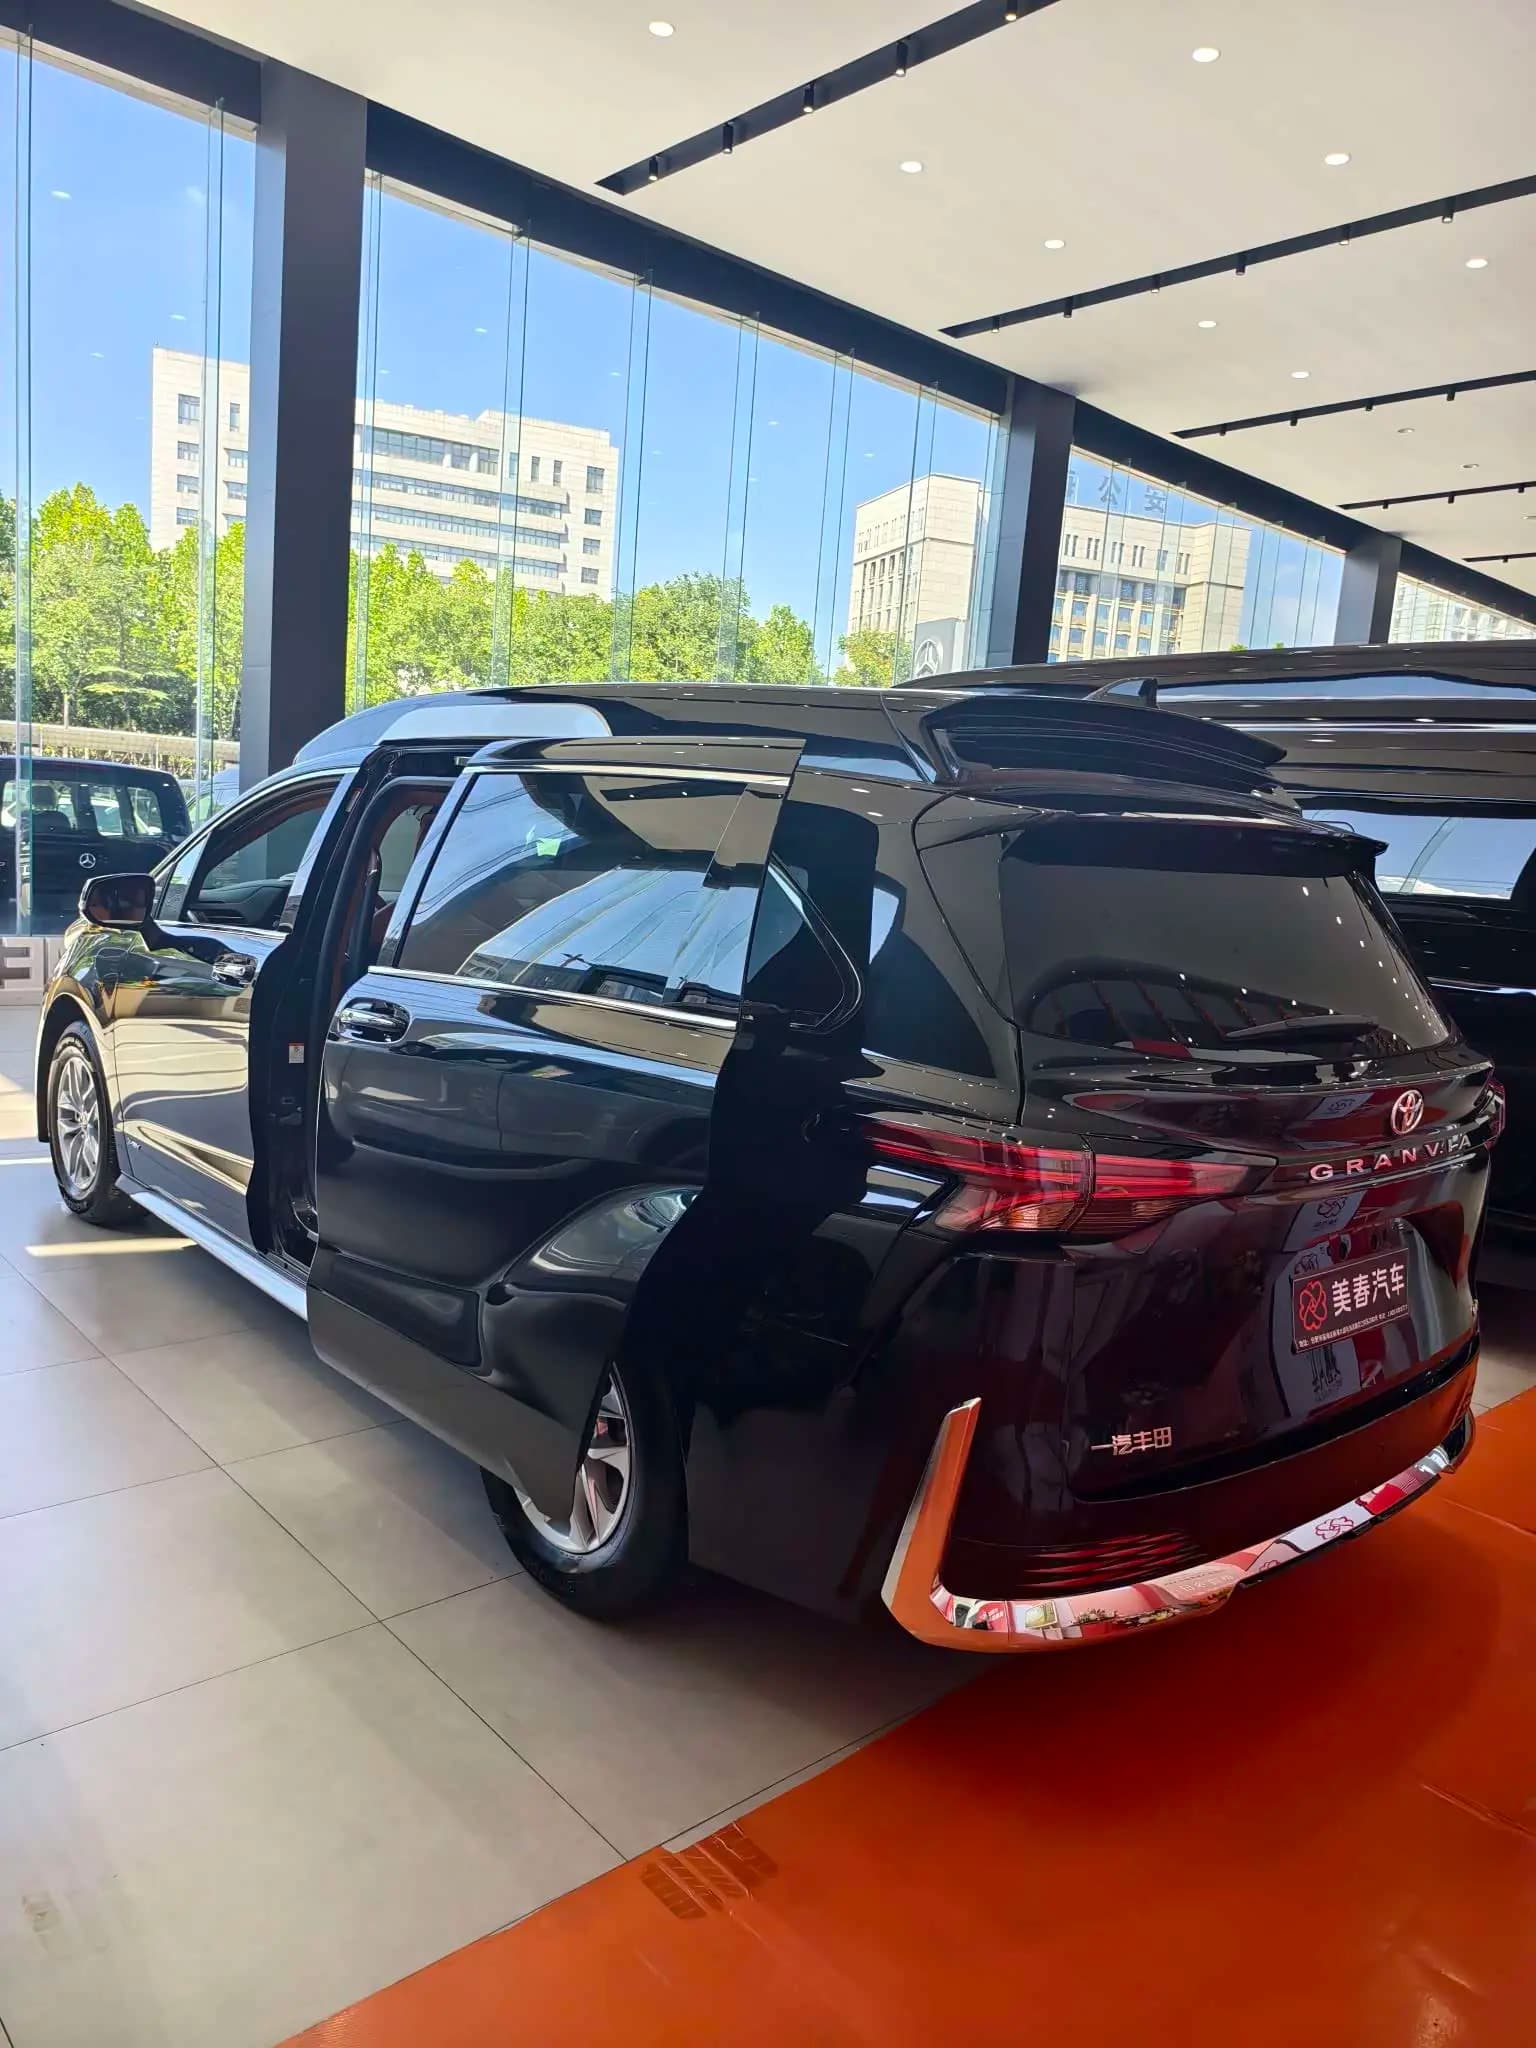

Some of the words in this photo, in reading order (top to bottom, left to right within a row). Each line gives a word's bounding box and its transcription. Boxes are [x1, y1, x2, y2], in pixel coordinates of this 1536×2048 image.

[1332, 1262, 1405, 1317] 美春汽车
[1091, 1427, 1171, 1455] 一汽丰田
